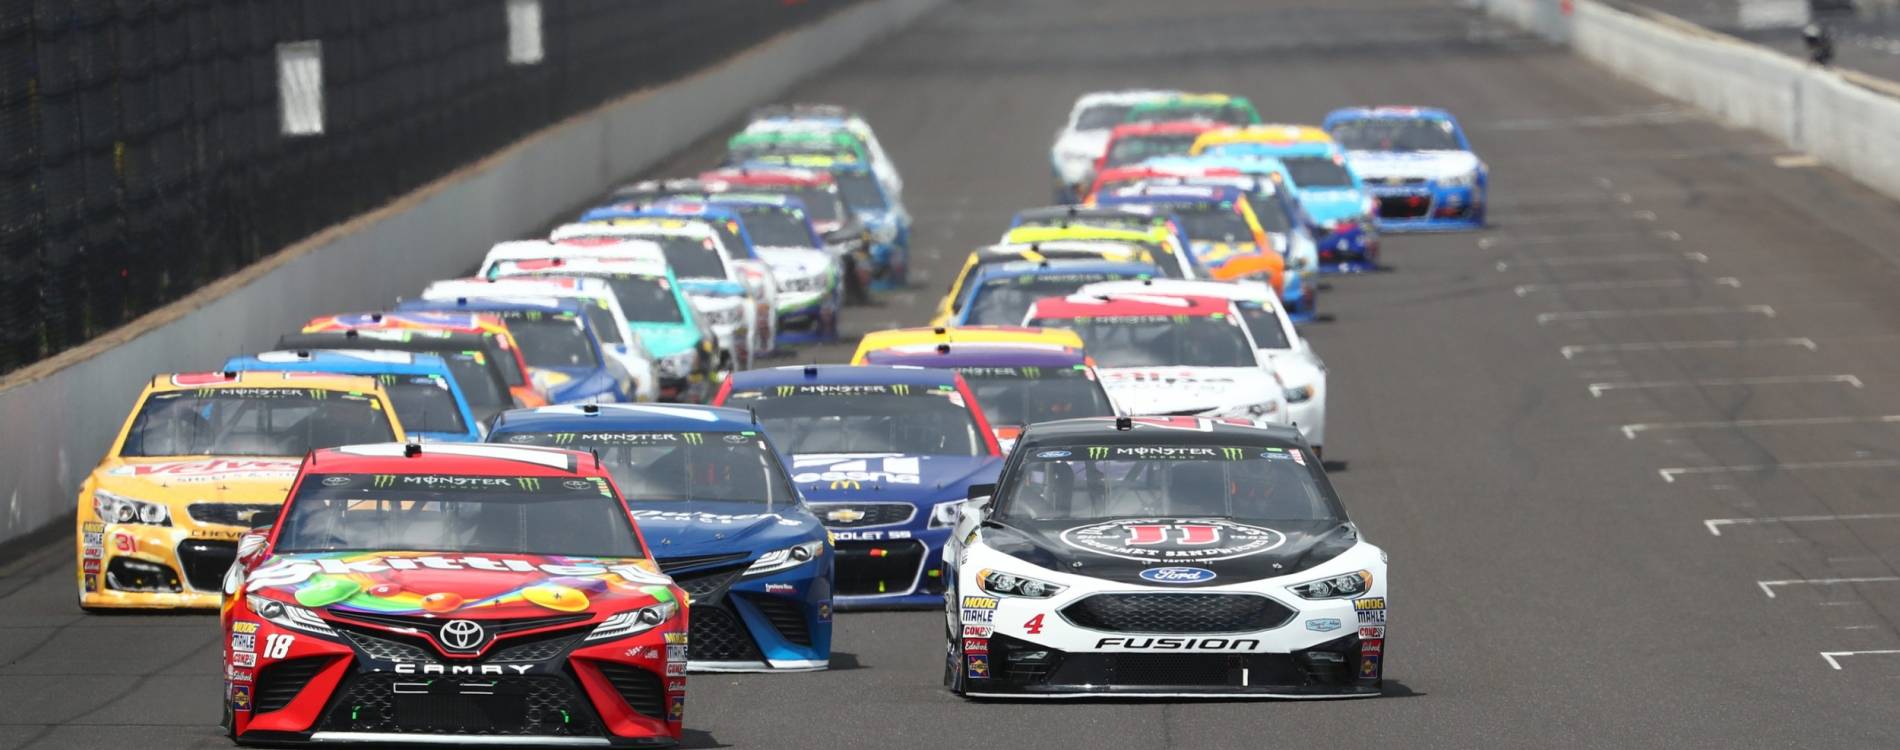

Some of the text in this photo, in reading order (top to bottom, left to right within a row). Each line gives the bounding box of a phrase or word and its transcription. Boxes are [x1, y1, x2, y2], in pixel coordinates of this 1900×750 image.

[221, 388, 303, 397] MONSTER
[801, 384, 887, 393] MONSTER
[582, 433, 677, 441] MONSTER
[1116, 447, 1217, 456] MONSTER
[403, 475, 512, 486] MONSTER
[888, 531, 912, 539] SS
[115, 533, 137, 553] 31
[246, 555, 674, 591] Skittles
[964, 597, 998, 609] MOOG
[1356, 598, 1384, 609] MOOG
[963, 610, 994, 622] MAHLE
[1357, 610, 1385, 623] MAHLE
[1024, 613, 1045, 635] 4
[1360, 627, 1377, 637] COMP
[262, 633, 296, 659] 18
[1095, 637, 1261, 651] FUSION
[394, 663, 535, 675] CAMRY
